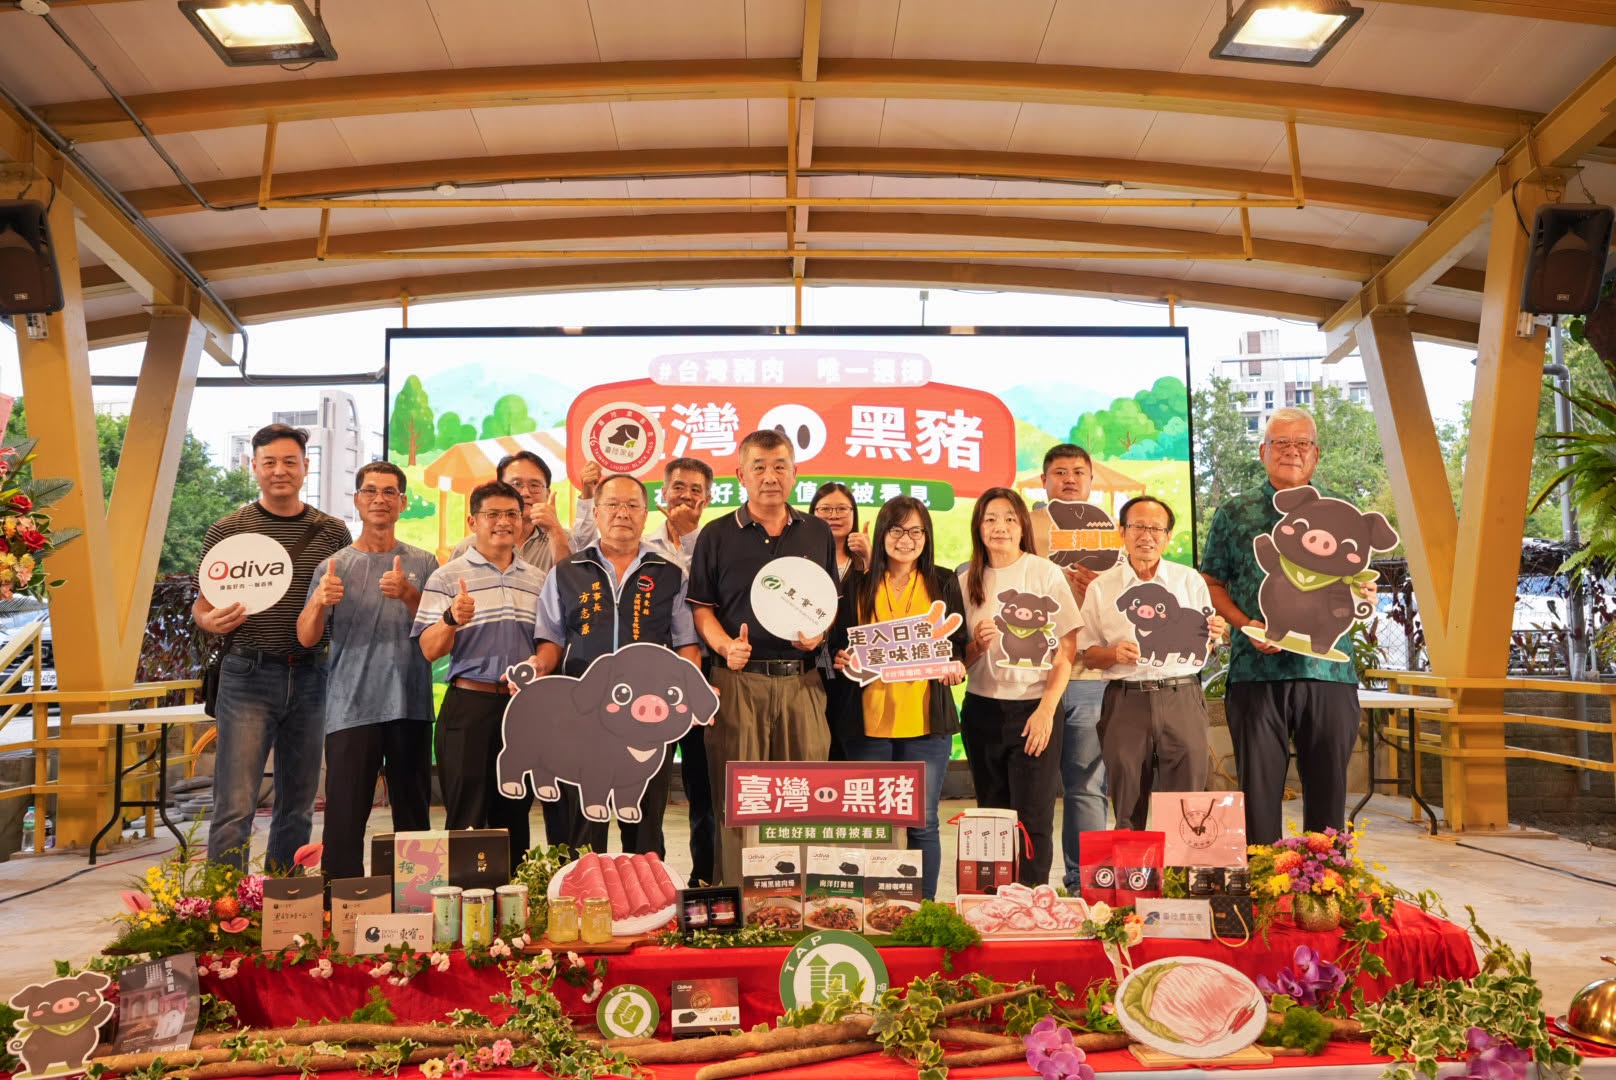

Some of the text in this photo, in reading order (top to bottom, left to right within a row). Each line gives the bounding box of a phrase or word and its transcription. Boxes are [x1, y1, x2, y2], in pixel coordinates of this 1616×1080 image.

[845, 405, 984, 472] 黑豬
[795, 481, 930, 506] 值被看見
[849, 622, 932, 647] 走入日常
[868, 640, 951, 666] 臺味擔當
[737, 775, 914, 816] 臺灣 黑豬
[765, 827, 887, 839] 在地好豬 值得被看見
[784, 935, 822, 973] TAP
[608, 985, 637, 997] TAP
